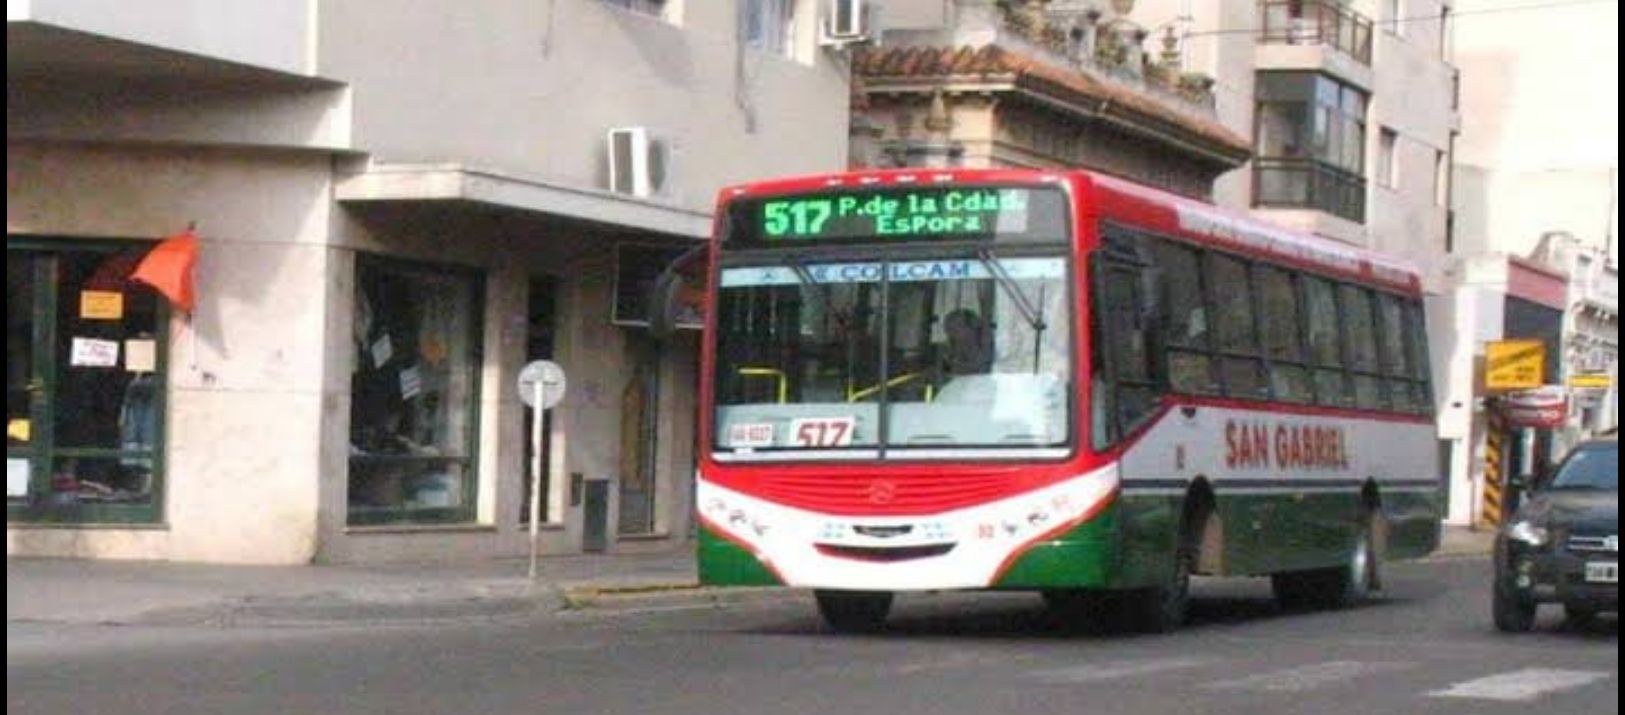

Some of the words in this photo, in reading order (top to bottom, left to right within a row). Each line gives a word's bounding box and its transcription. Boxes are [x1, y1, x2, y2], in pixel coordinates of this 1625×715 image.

[764, 199, 831, 235] 517
[908, 193, 938, 214] la
[797, 421, 849, 446] 517
[1226, 418, 1269, 470] SAN
[1274, 422, 1349, 470] GABRIEL
